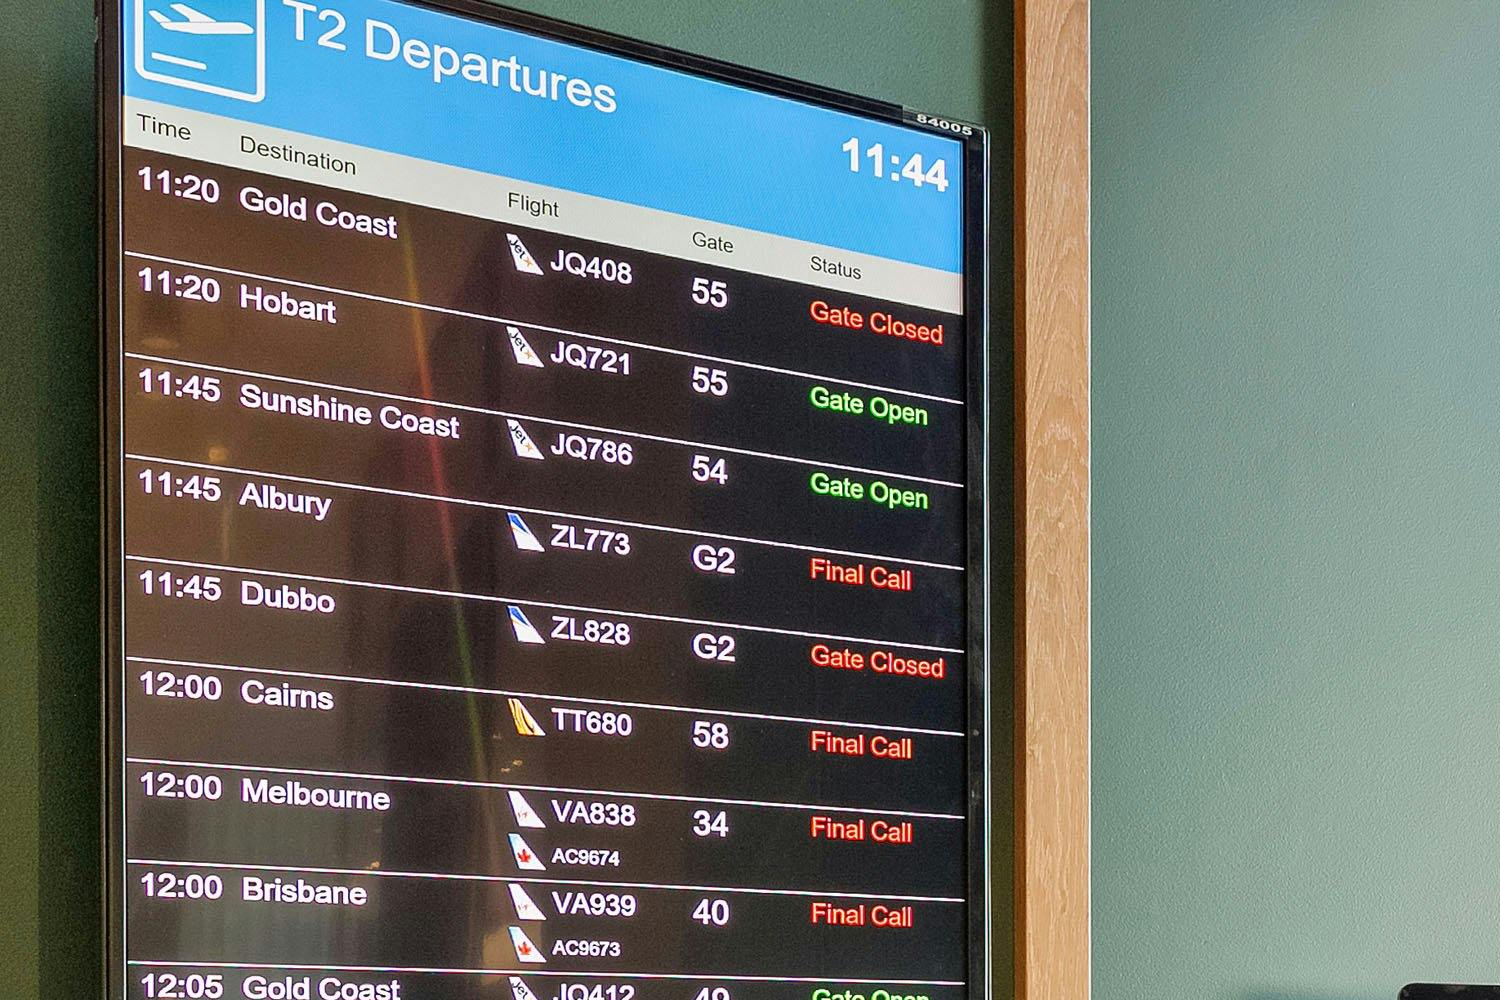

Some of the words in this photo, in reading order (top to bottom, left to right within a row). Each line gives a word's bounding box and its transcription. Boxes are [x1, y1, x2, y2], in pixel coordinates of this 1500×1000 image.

[283, 0, 345, 50] T2
[366, 18, 617, 112] Departures
[137, 114, 190, 140] Time
[917, 114, 973, 137] 84005
[240, 136, 357, 176] Destination
[843, 138, 948, 192] 11:44
[139, 167, 219, 202] 11:20
[240, 187, 306, 220] Gold
[316, 202, 397, 238] Coast
[509, 193, 558, 217] Flight
[693, 232, 733, 252] Gate
[551, 250, 632, 284] JQ408
[811, 256, 861, 279] Status
[139, 267, 220, 302] 11:20
[692, 278, 727, 307] 55
[241, 285, 336, 323] Hobart
[811, 301, 863, 329] Gate
[870, 313, 943, 344] Closed
[551, 342, 631, 374] JQ721
[140, 368, 221, 401] 11:45
[693, 366, 728, 395] 55
[240, 384, 371, 424] Sunshine
[380, 406, 459, 438] Coast
[811, 387, 863, 413] Gate
[870, 397, 927, 425] Open
[551, 434, 632, 465] JQ786
[693, 455, 728, 484] 54
[140, 469, 221, 501] 11:45
[811, 473, 863, 499] Gate
[870, 482, 927, 509] Open
[239, 482, 332, 520] Albury
[551, 524, 630, 555] ZL773
[693, 545, 735, 573] G2
[140, 570, 221, 600] 11:45
[811, 558, 864, 584] Final
[870, 567, 911, 590] Call
[242, 581, 335, 612] Dubbo
[551, 616, 630, 645] ZL828
[693, 633, 735, 661] G2
[811, 645, 864, 670] Gate
[870, 651, 944, 678] Closed
[141, 671, 221, 700] 12:00
[242, 680, 333, 709] Cairns
[552, 708, 632, 735] TT680
[693, 721, 728, 748] 58
[812, 731, 864, 755] Final
[870, 736, 911, 758] Call
[141, 772, 221, 799] 12:00
[243, 778, 390, 810] Melbourne
[552, 800, 635, 826] VA838
[694, 810, 728, 837] 34
[811, 817, 864, 840] Final
[871, 821, 912, 843] Call
[552, 848, 619, 866] AC9674
[142, 873, 222, 899] 12:00
[243, 877, 367, 905] Brisbane
[552, 892, 636, 916] VA939
[693, 899, 729, 925] 40
[812, 903, 865, 925] Final
[871, 906, 912, 927] Call
[552, 940, 620, 956] AC9673
[142, 974, 223, 998] 12:05
[243, 976, 309, 1000] Gold
